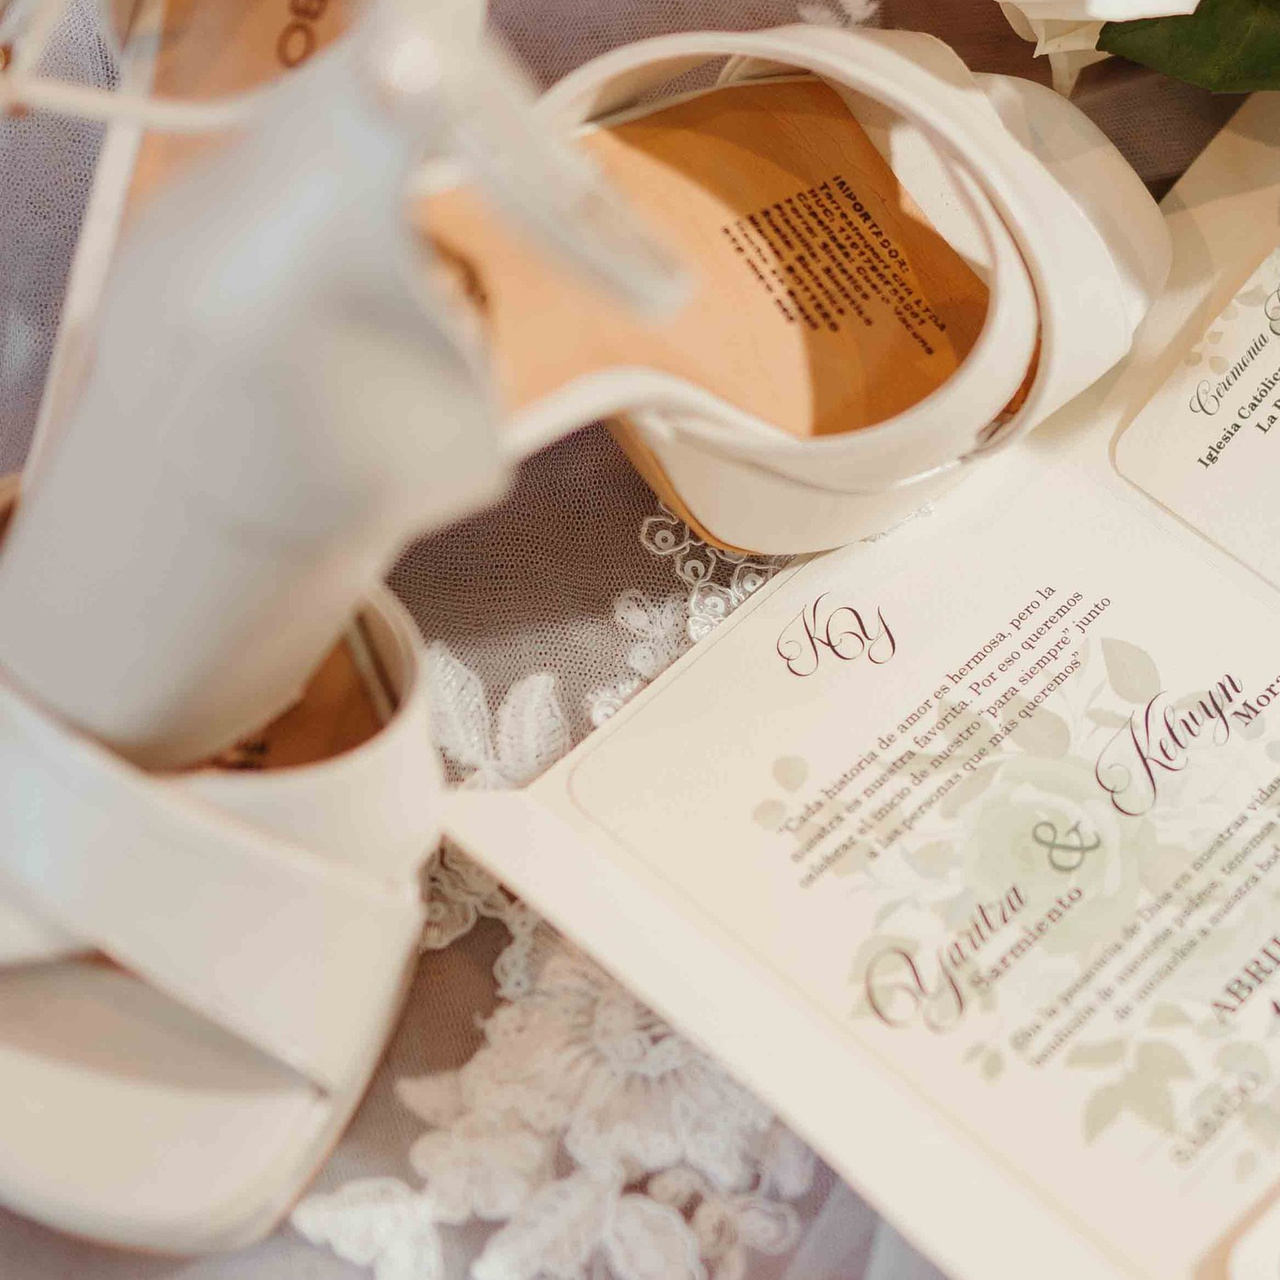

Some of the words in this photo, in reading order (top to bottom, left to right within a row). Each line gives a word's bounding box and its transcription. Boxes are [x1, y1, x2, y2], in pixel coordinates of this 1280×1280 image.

[833, 175, 909, 273] IMPORTADOR:
[1188, 332, 1270, 416] Ceremonia
[1255, 414, 1278, 434] La
[1196, 422, 1242, 470] Iglesia
[820, 750, 879, 802] historia
[876, 732, 898, 752] de
[896, 698, 934, 734] amor
[932, 684, 951, 700] es
[945, 632, 1013, 686] hermosa,
[1008, 600, 1042, 632] pero
[1035, 586, 1056, 601] la
[862, 748, 917, 800] nuestra
[912, 700, 974, 750] favorita.
[968, 670, 998, 698] Por
[996, 650, 1022, 674] eso
[1020, 590, 1084, 652] queremos
[870, 786, 912, 822] inicio
[908, 768, 930, 788] de
[928, 720, 982, 770] nuestro
[978, 686, 1020, 720] “para
[1018, 626, 1072, 686] siempre”
[1072, 596, 1112, 635] junto
[900, 772, 964, 832] personas
[960, 746, 990, 774] que
[986, 718, 1020, 748] más
[1018, 650, 1082, 720] queremos”
[1030, 820, 1102, 876] &
[1094, 672, 1264, 818] Kelvyn
[1190, 812, 1249, 872] nuestras
[1219, 820, 1277, 878] tenemos
[970, 886, 1084, 990] Sarmiento
